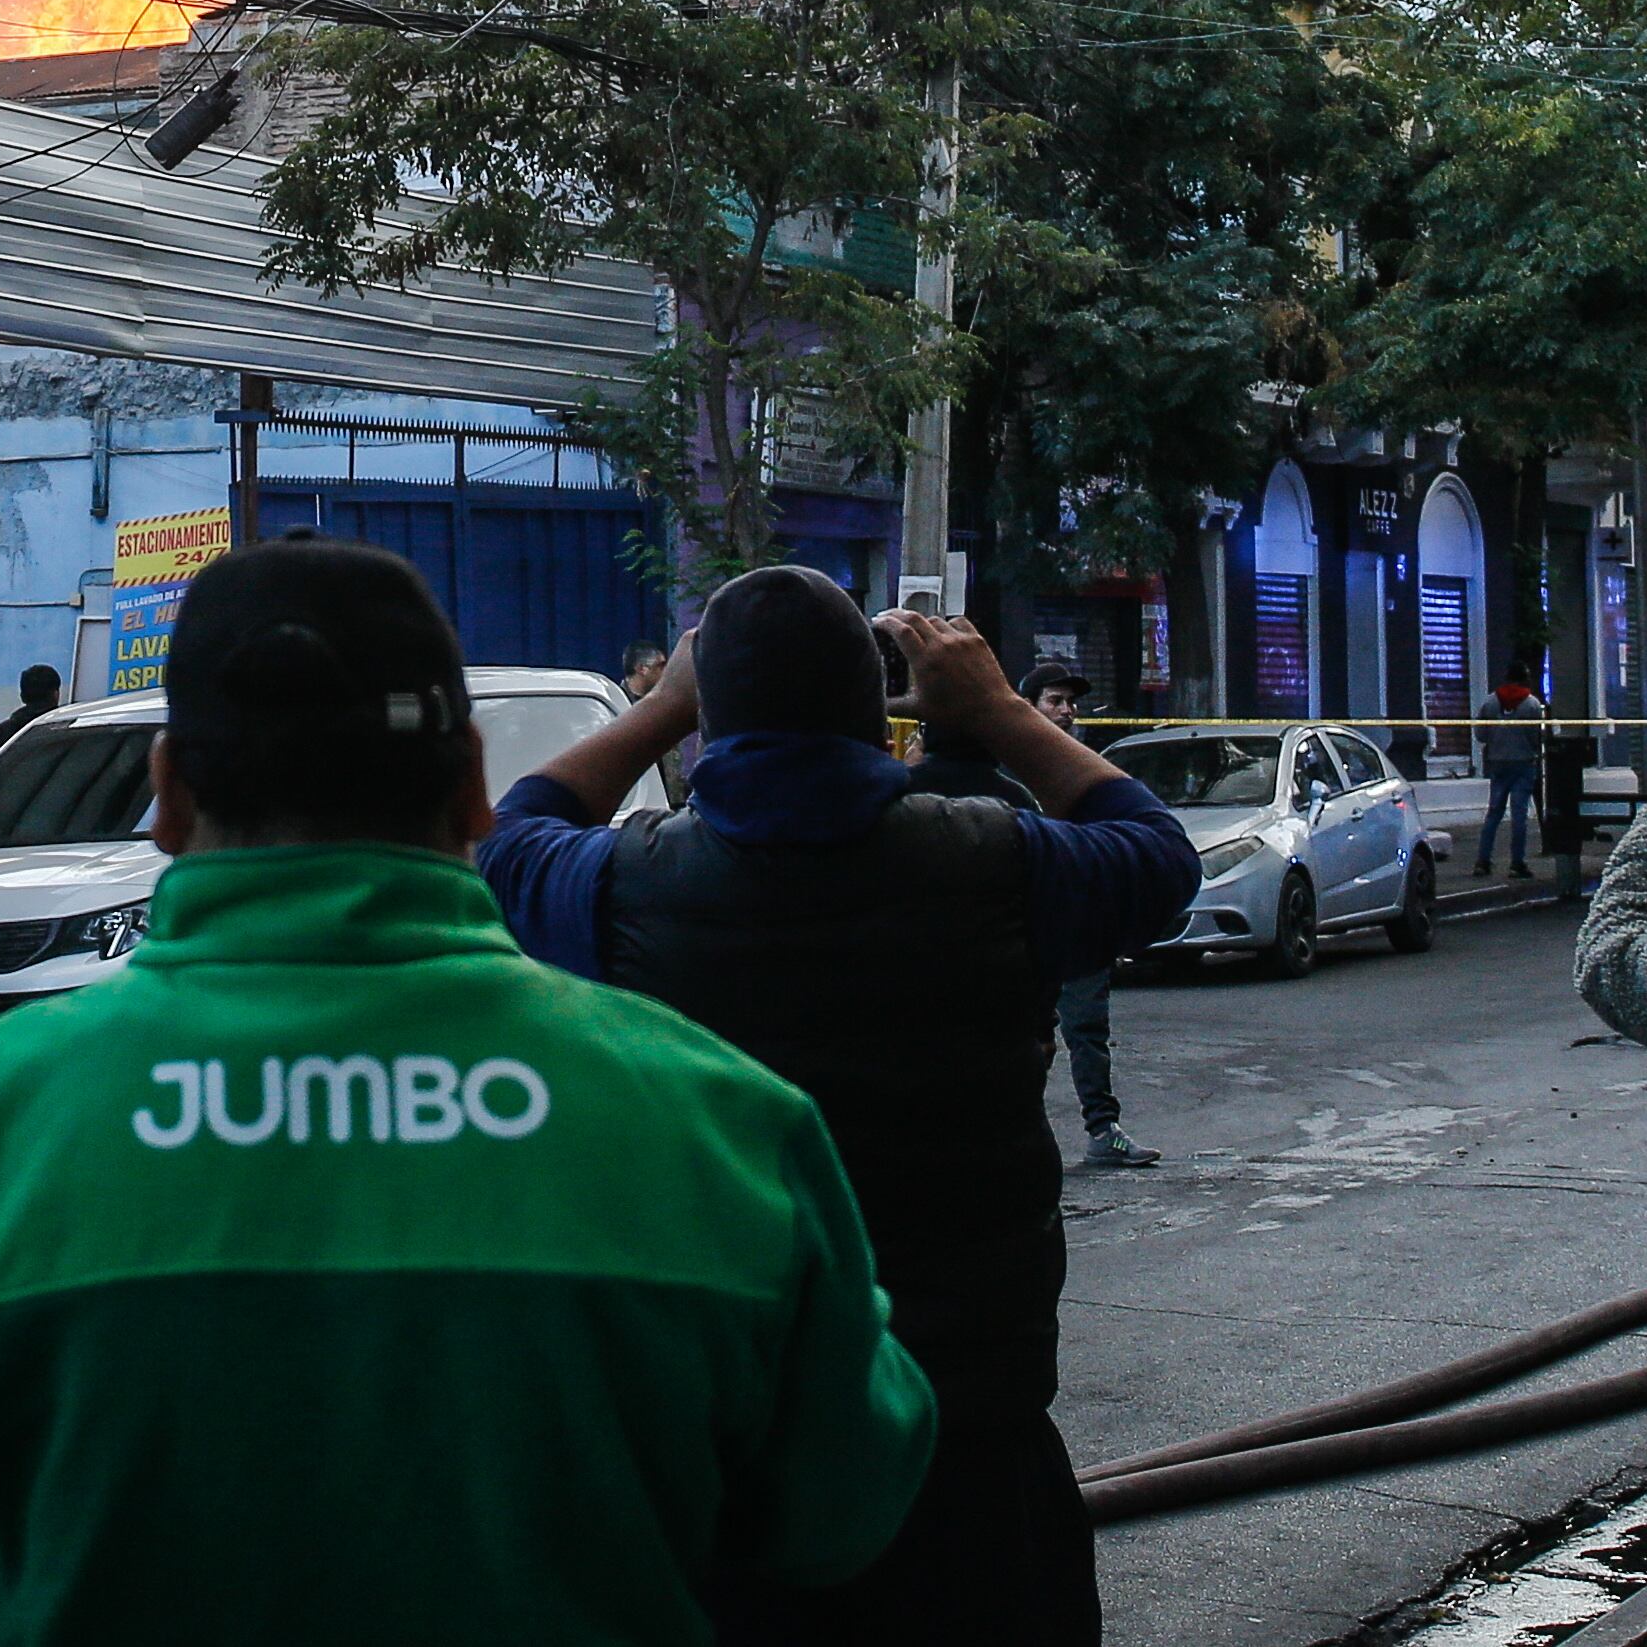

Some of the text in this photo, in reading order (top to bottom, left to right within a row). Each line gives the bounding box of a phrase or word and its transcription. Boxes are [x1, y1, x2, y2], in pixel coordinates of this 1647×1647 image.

[118, 520, 230, 557] ESTACIONAMIENTO
[175, 547, 228, 566] 24/7
[164, 589, 175, 601] DE
[122, 610, 145, 632] EL
[132, 1054, 551, 1150] JUMBO
